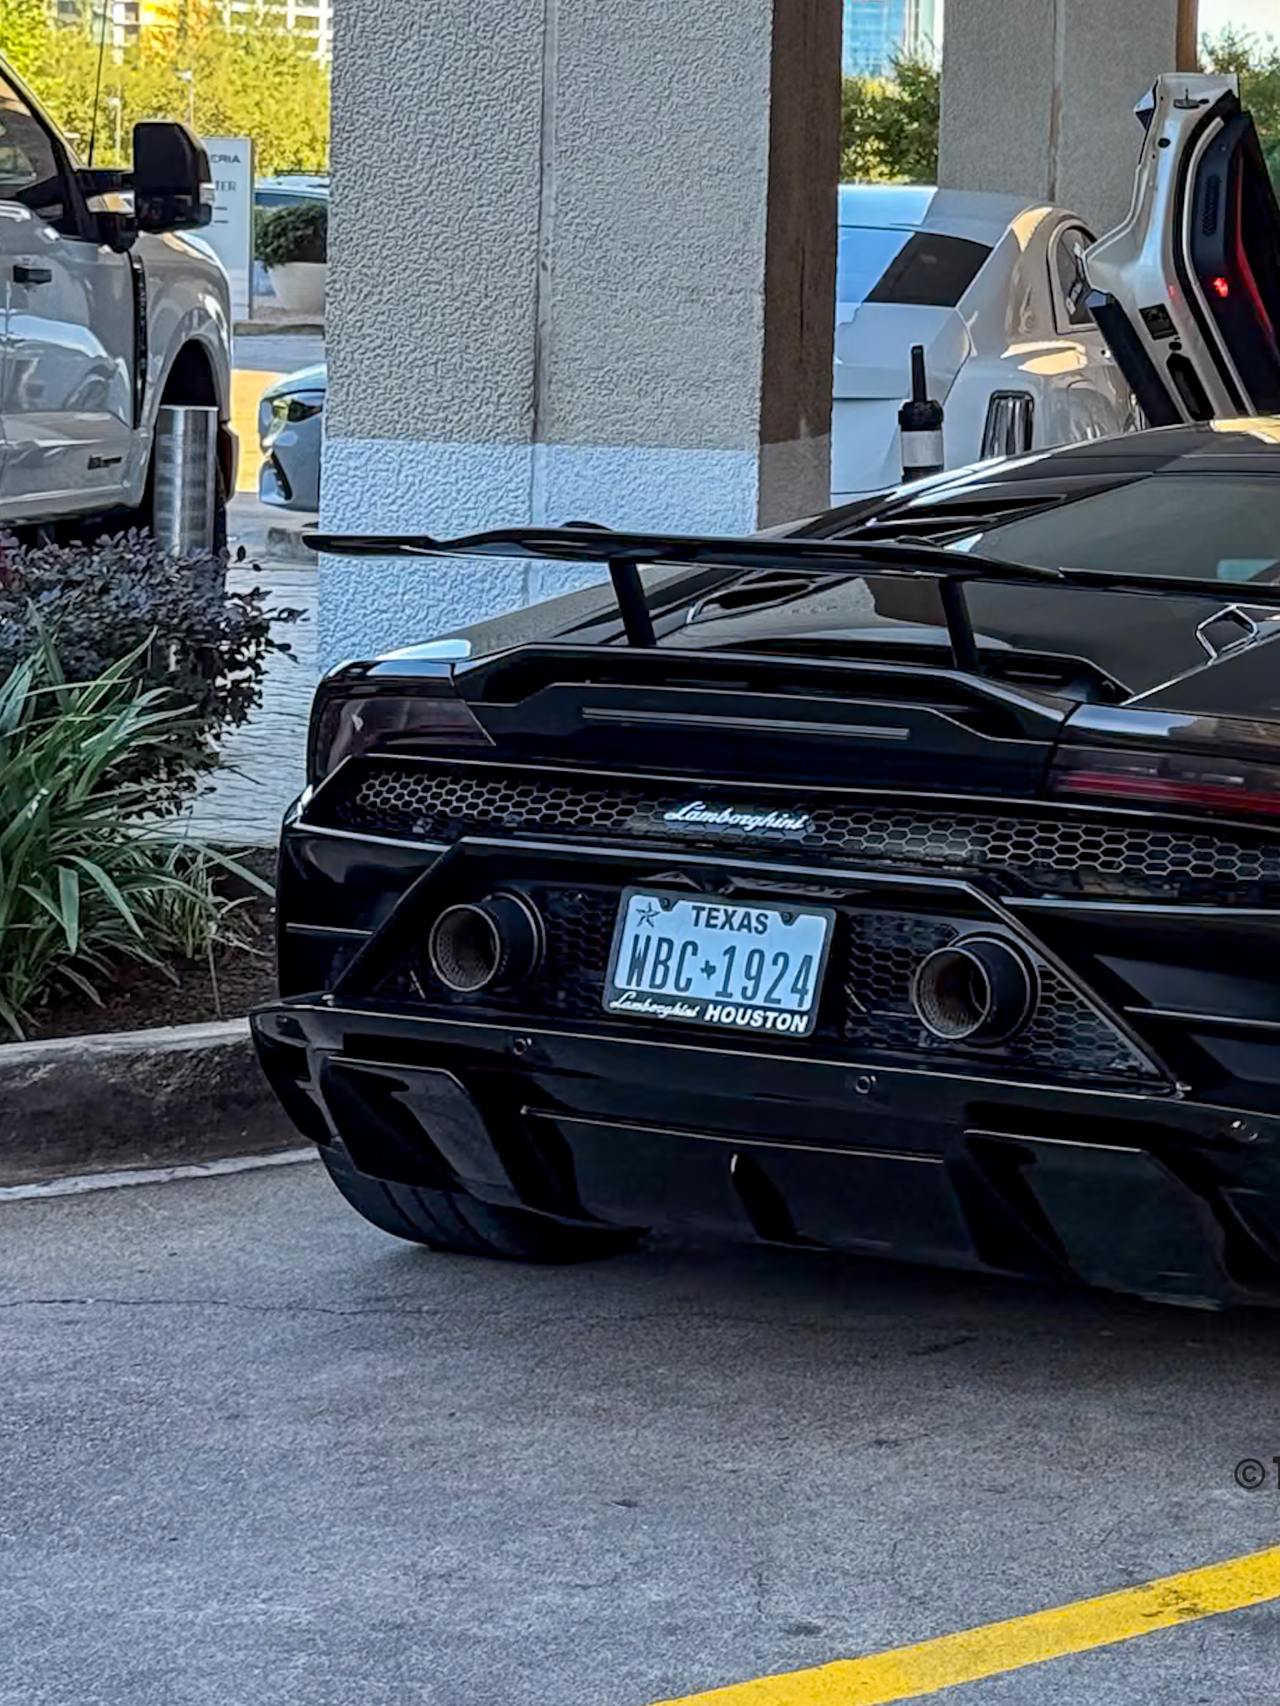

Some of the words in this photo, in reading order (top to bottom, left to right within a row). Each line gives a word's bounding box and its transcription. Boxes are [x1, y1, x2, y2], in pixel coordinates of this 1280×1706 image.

[210, 154, 241, 164] ERIA
[663, 801, 810, 831] Lamborghini
[691, 905, 769, 935] TEXAS
[609, 991, 701, 1018] Lamborghini
[704, 1003, 809, 1033] HOUSTON
